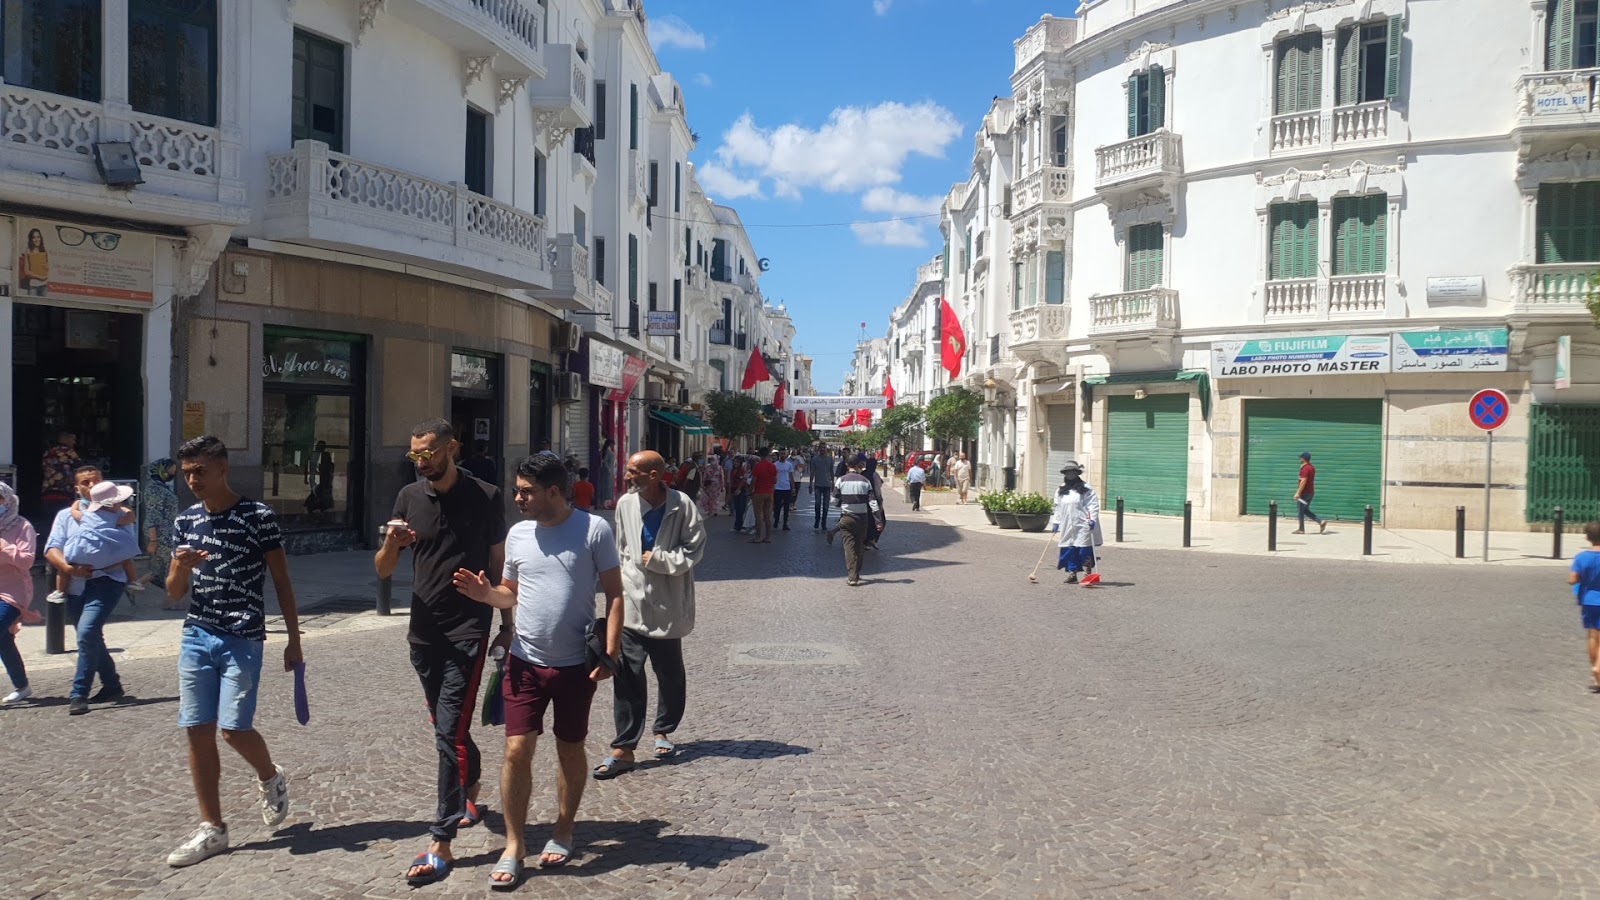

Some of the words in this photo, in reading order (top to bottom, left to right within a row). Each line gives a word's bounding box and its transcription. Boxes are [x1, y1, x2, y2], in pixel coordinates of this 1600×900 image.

[1537, 98, 1568, 107] HOTEL
[1572, 96, 1587, 105] RIF
[1275, 339, 1328, 351] FUJIFILM
[1221, 366, 1258, 376] LABO
[1262, 363, 1312, 374] PHOTO
[1317, 360, 1380, 372] MASTER
[1432, 358, 1464, 370] الصور
[1469, 358, 1500, 369] مختبر
[324, 360, 347, 380] iris
[202, 535, 222, 546] Palm
